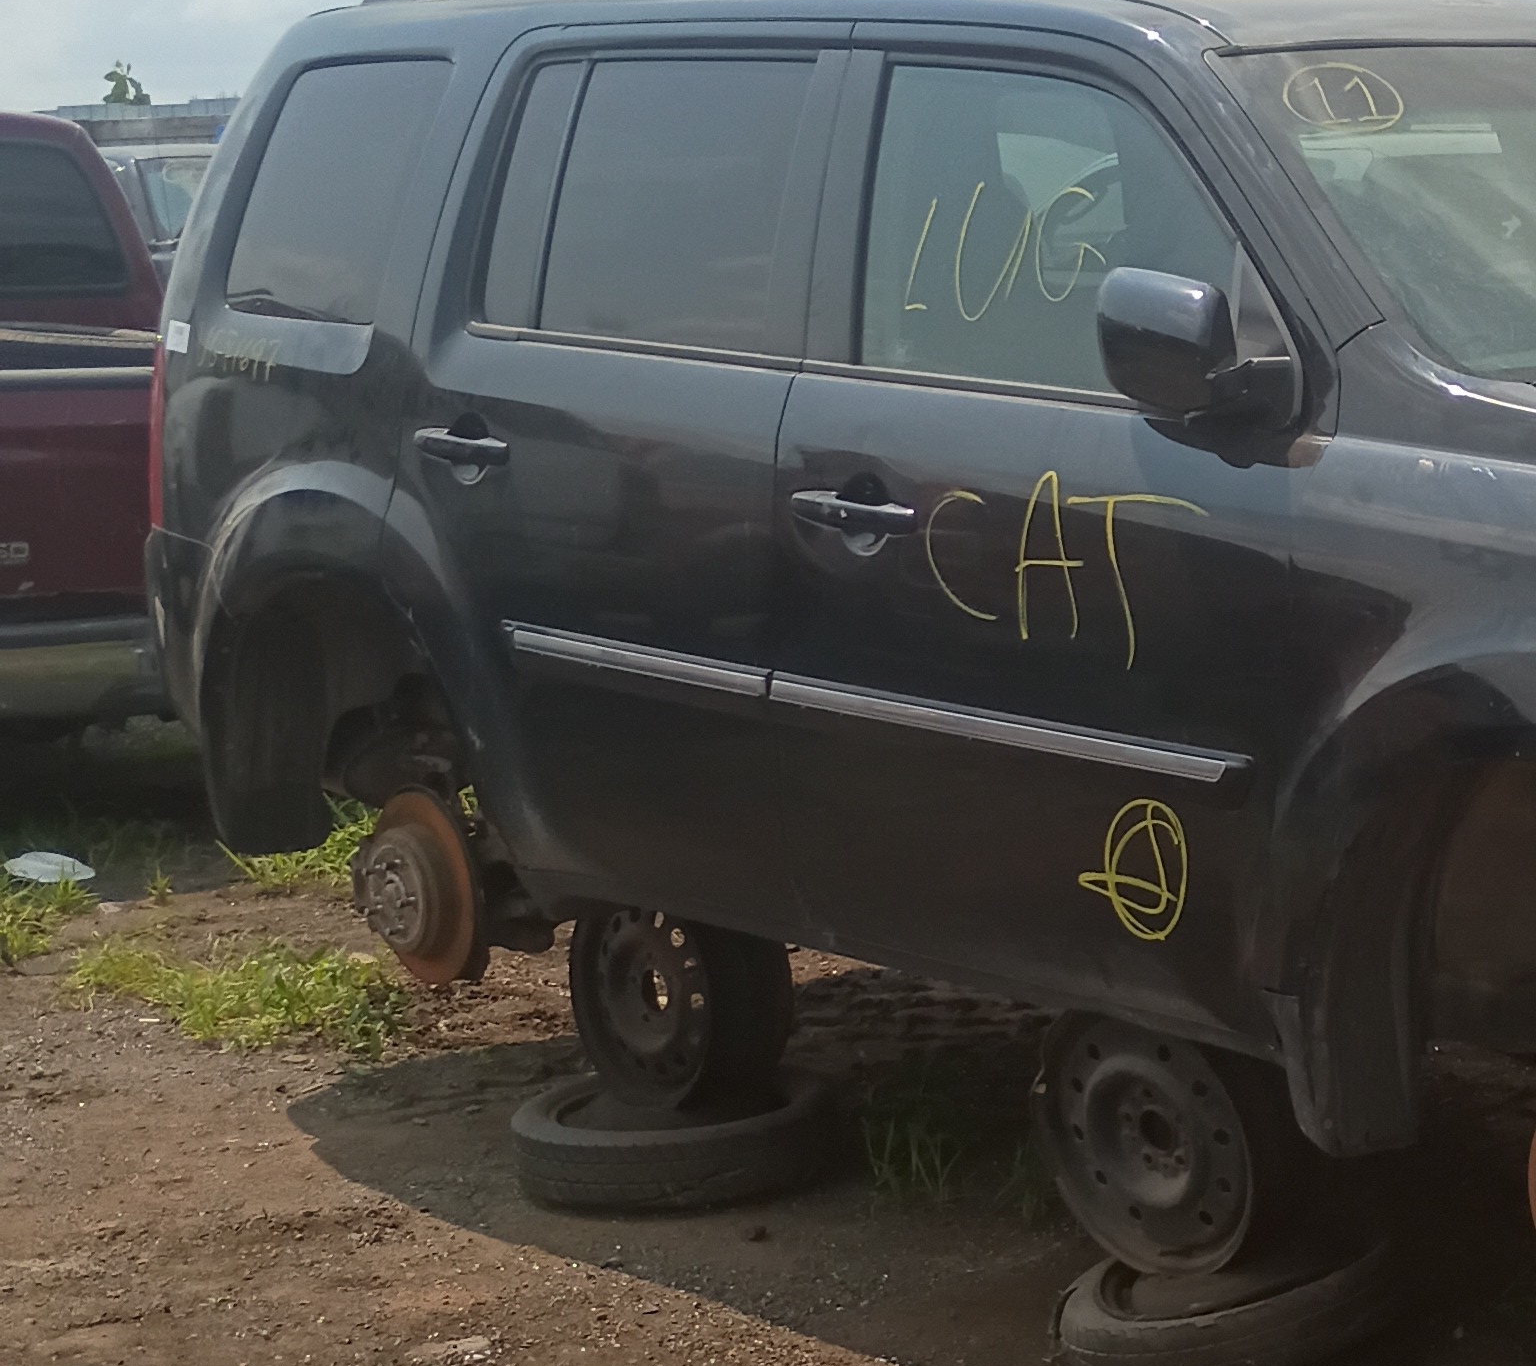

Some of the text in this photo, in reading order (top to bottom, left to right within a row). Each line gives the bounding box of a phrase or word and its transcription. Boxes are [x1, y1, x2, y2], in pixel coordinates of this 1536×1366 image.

[1295, 75, 1397, 125] 11
[904, 181, 1106, 322] LUG
[926, 470, 1210, 671] CAT
